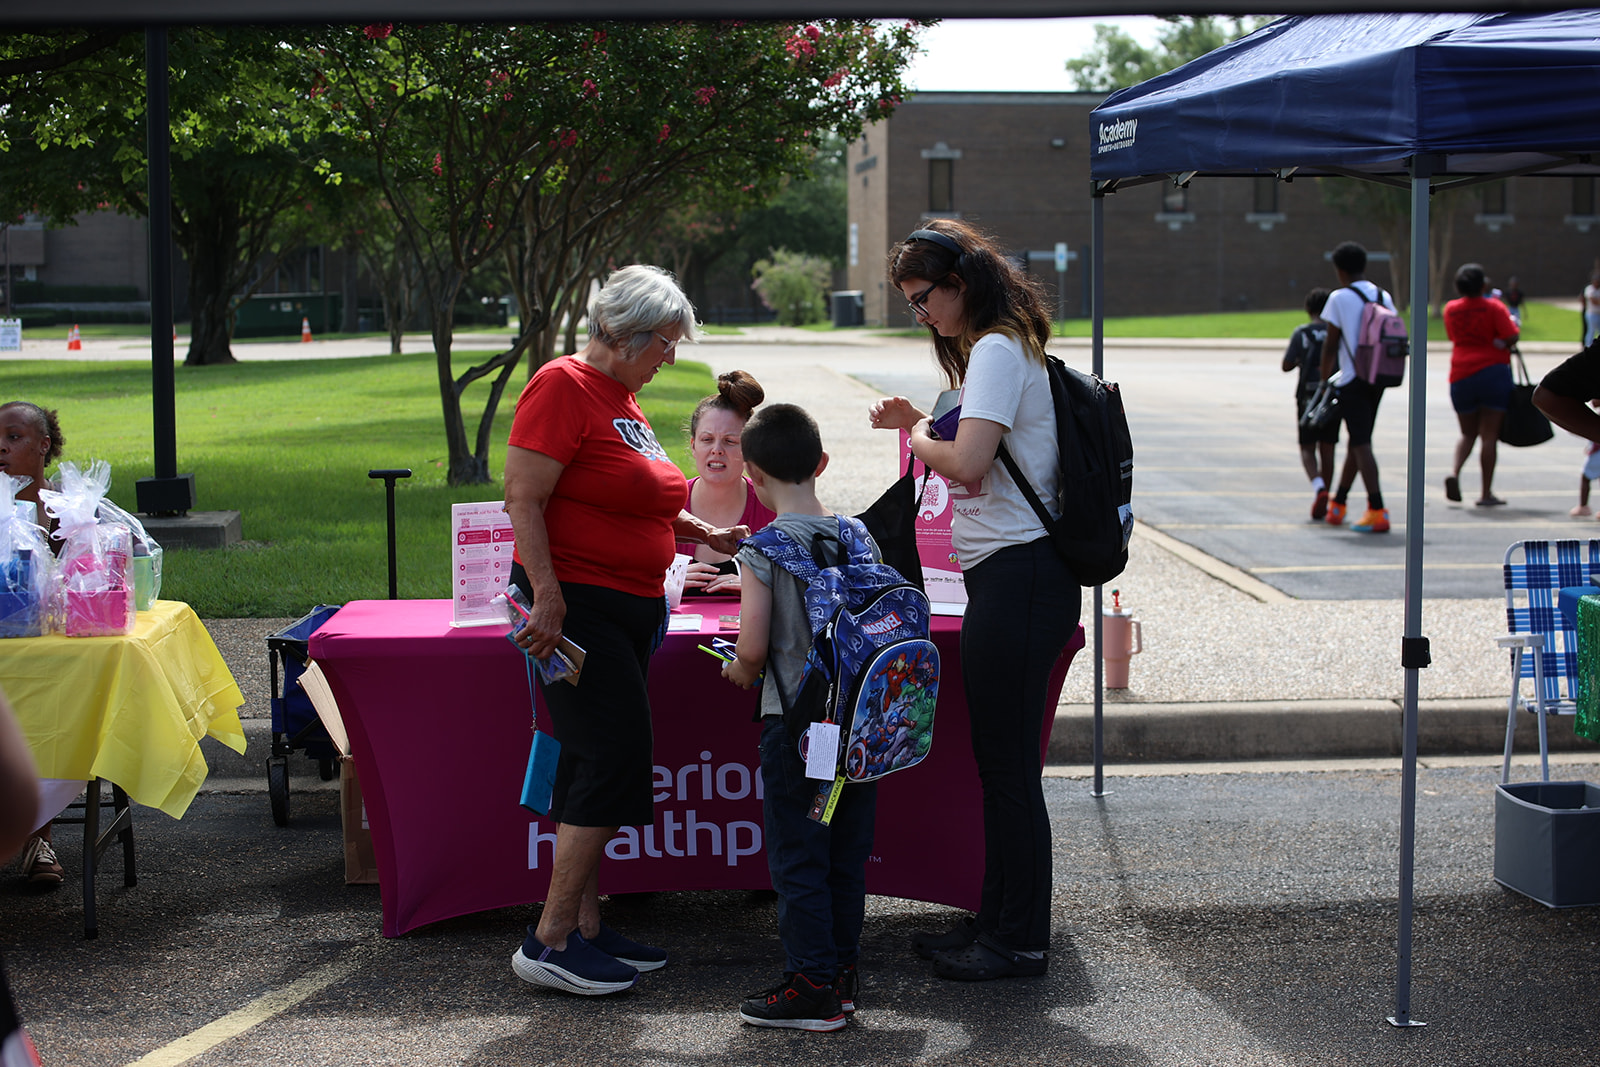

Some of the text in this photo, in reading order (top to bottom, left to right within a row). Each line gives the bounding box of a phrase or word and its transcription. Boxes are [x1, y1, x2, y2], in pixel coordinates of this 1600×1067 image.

[1099, 117, 1138, 145] Academy
[861, 613, 902, 635] MARVEL
[527, 809, 762, 870] halthp
